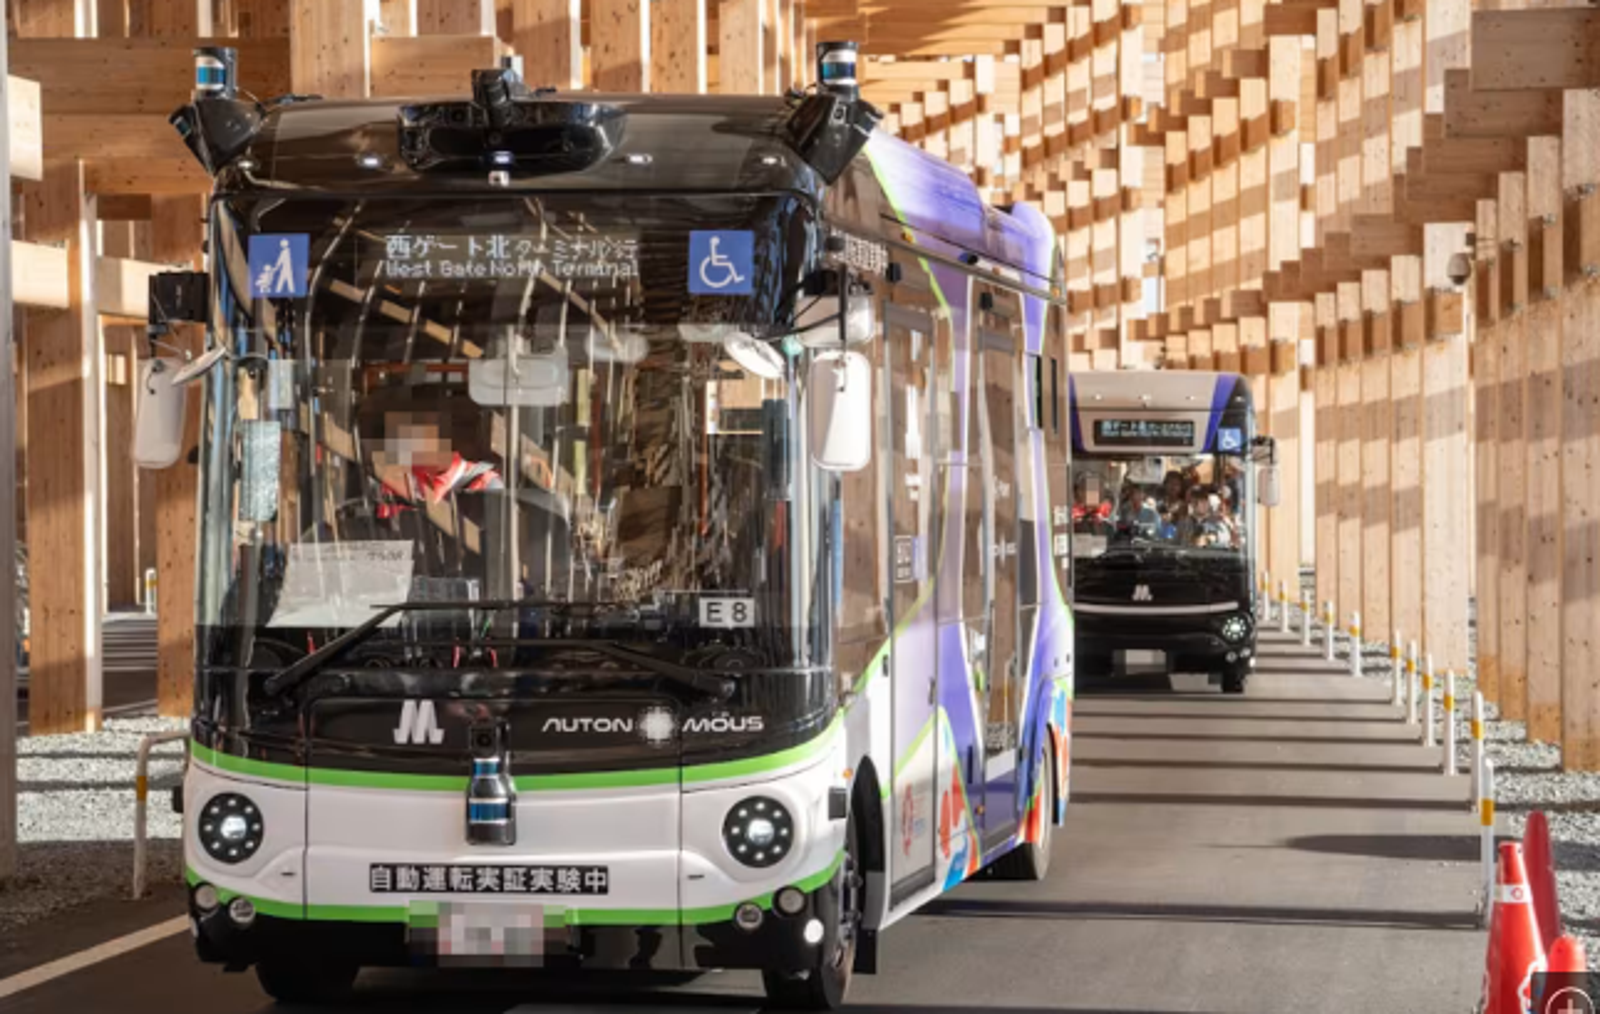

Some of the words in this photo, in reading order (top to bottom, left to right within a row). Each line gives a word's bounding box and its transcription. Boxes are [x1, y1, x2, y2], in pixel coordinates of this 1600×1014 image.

[385, 260, 432, 277] West
[440, 260, 487, 277] Gate
[490, 258, 546, 277] North
[552, 258, 639, 277] Terminal
[370, 865, 609, 892] 自動運転実証実験中
